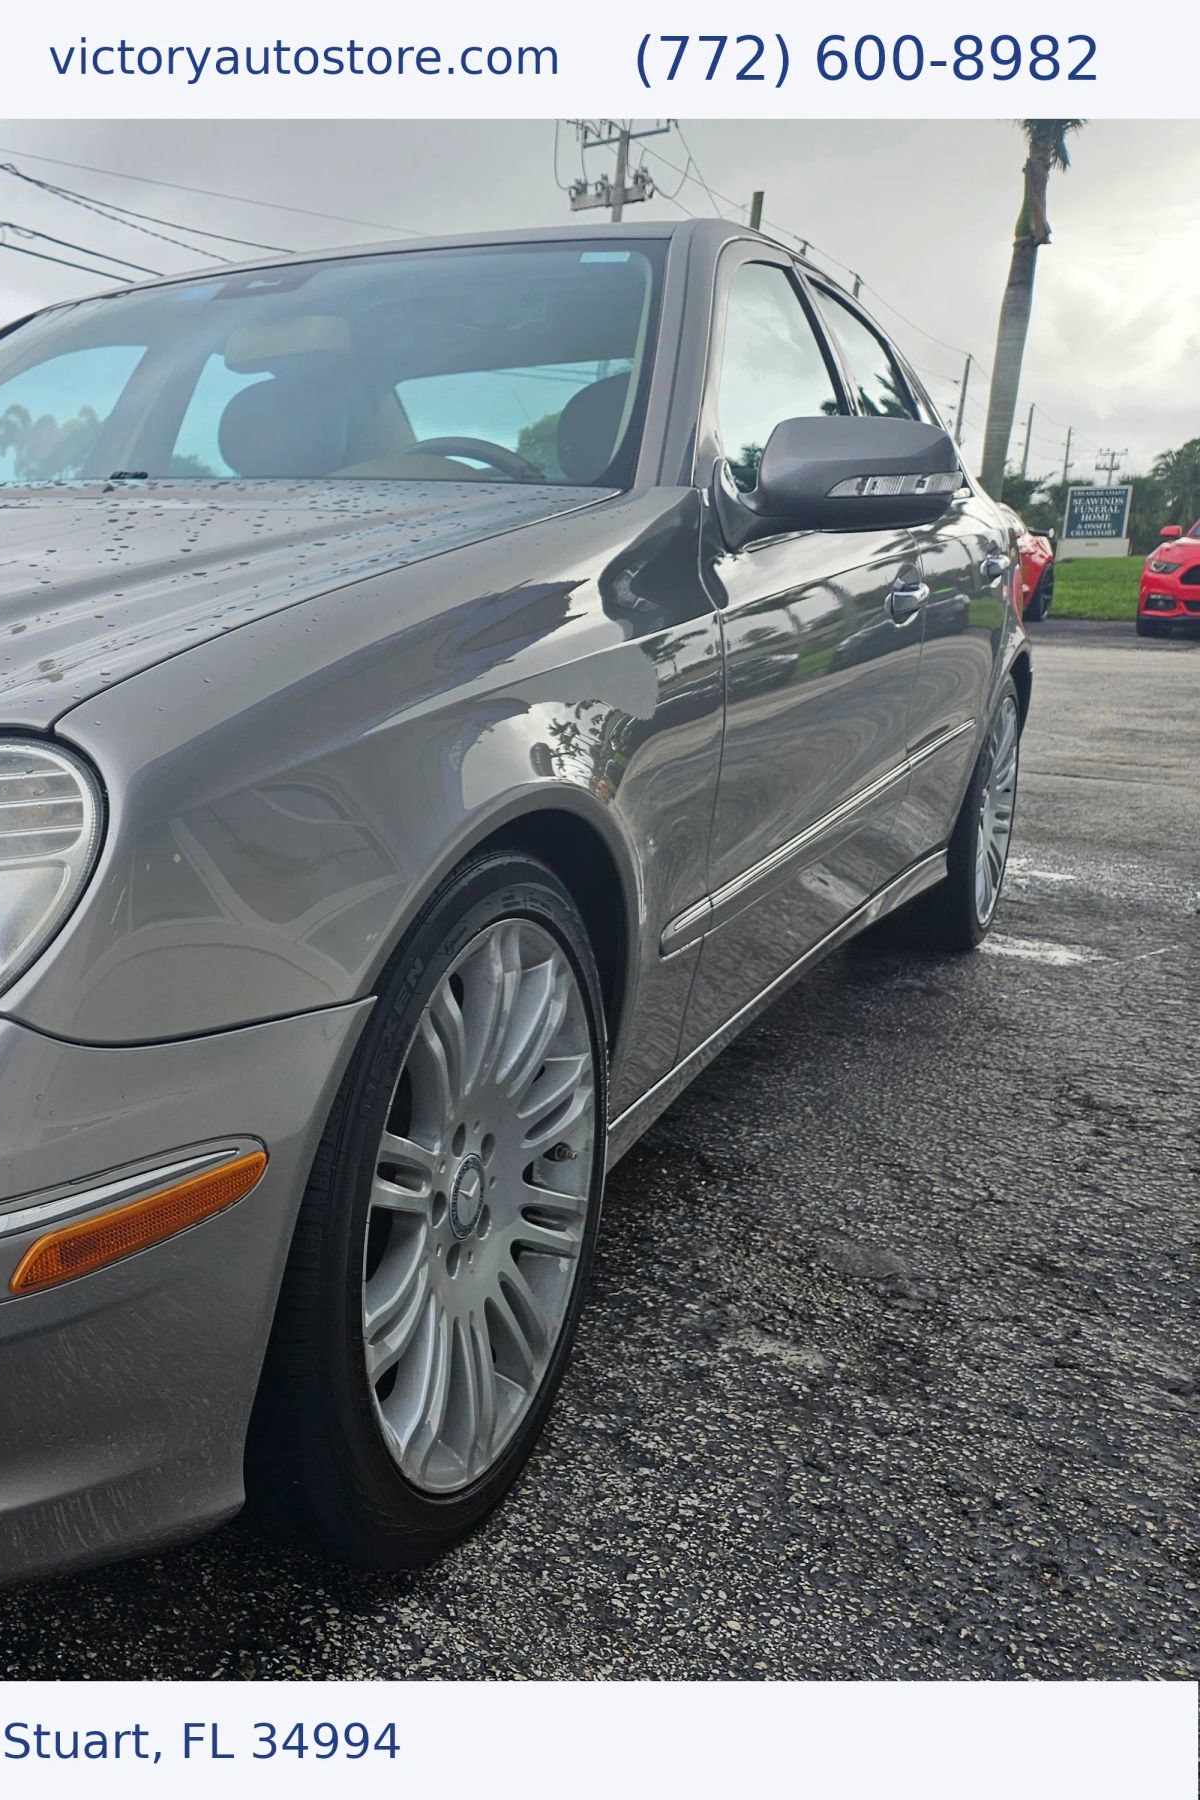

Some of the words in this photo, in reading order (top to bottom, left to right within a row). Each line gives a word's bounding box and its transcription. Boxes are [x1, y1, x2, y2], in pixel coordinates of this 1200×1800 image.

[1072, 496, 1124, 506] SEAWINDS
[1074, 505, 1120, 514] FUNERAL
[1081, 513, 1112, 522] HOME
